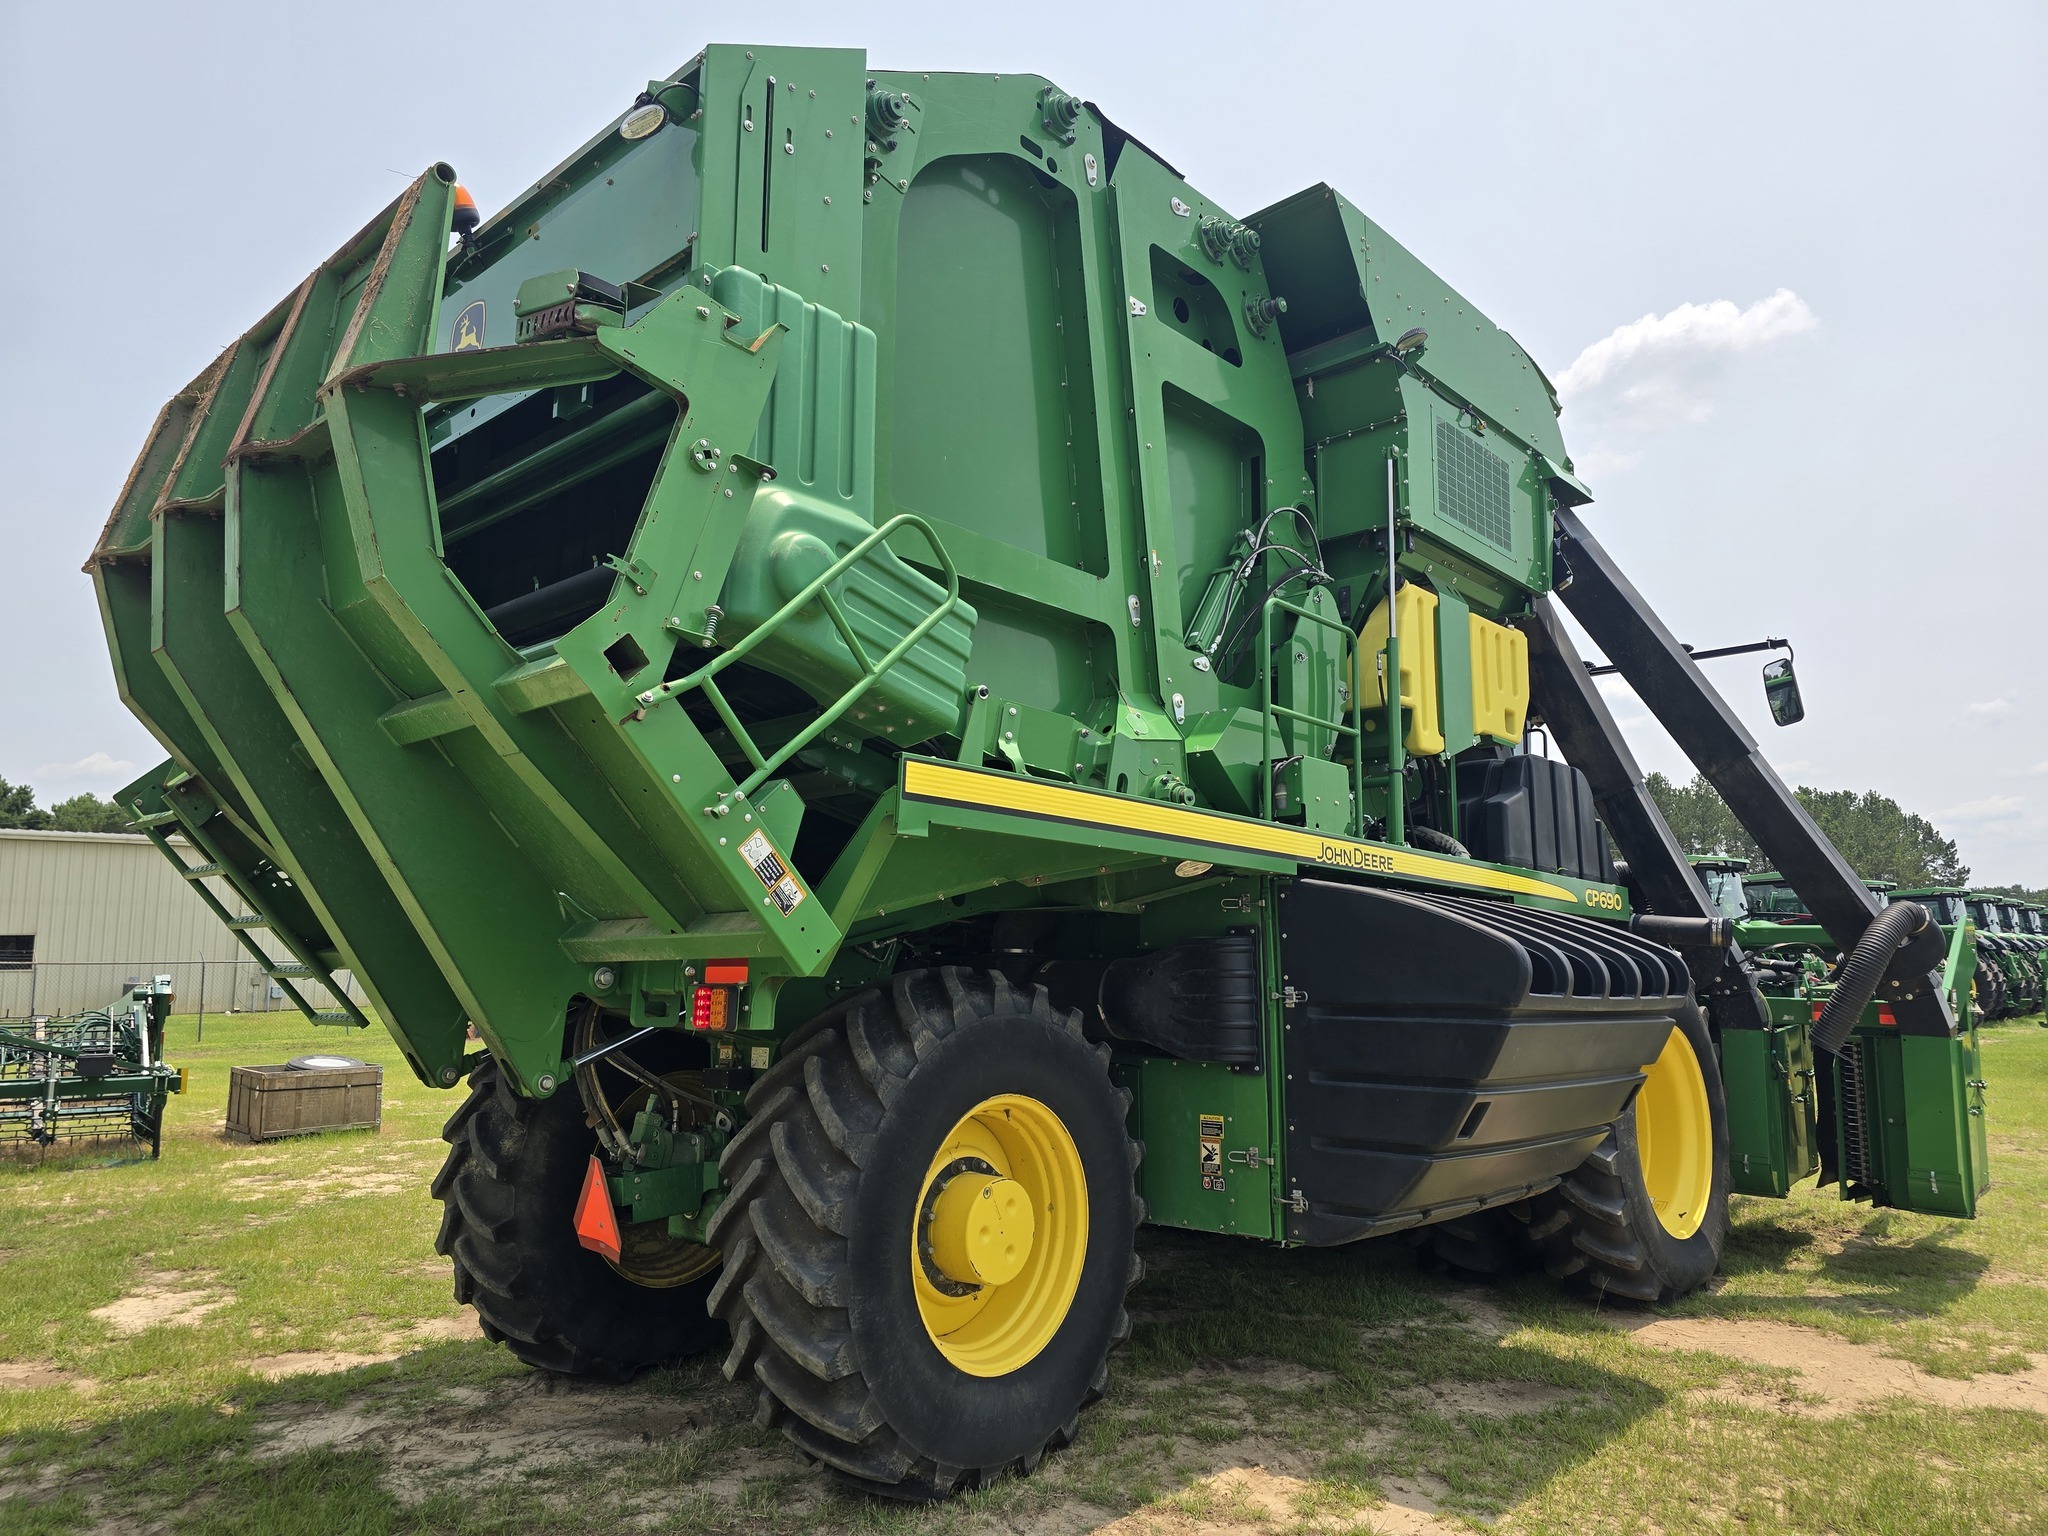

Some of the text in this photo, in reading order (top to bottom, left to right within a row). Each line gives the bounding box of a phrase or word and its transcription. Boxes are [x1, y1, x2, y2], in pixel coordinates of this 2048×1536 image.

[1317, 842, 1394, 871] JOHN DEERE
[1585, 888, 1622, 911] CP690
